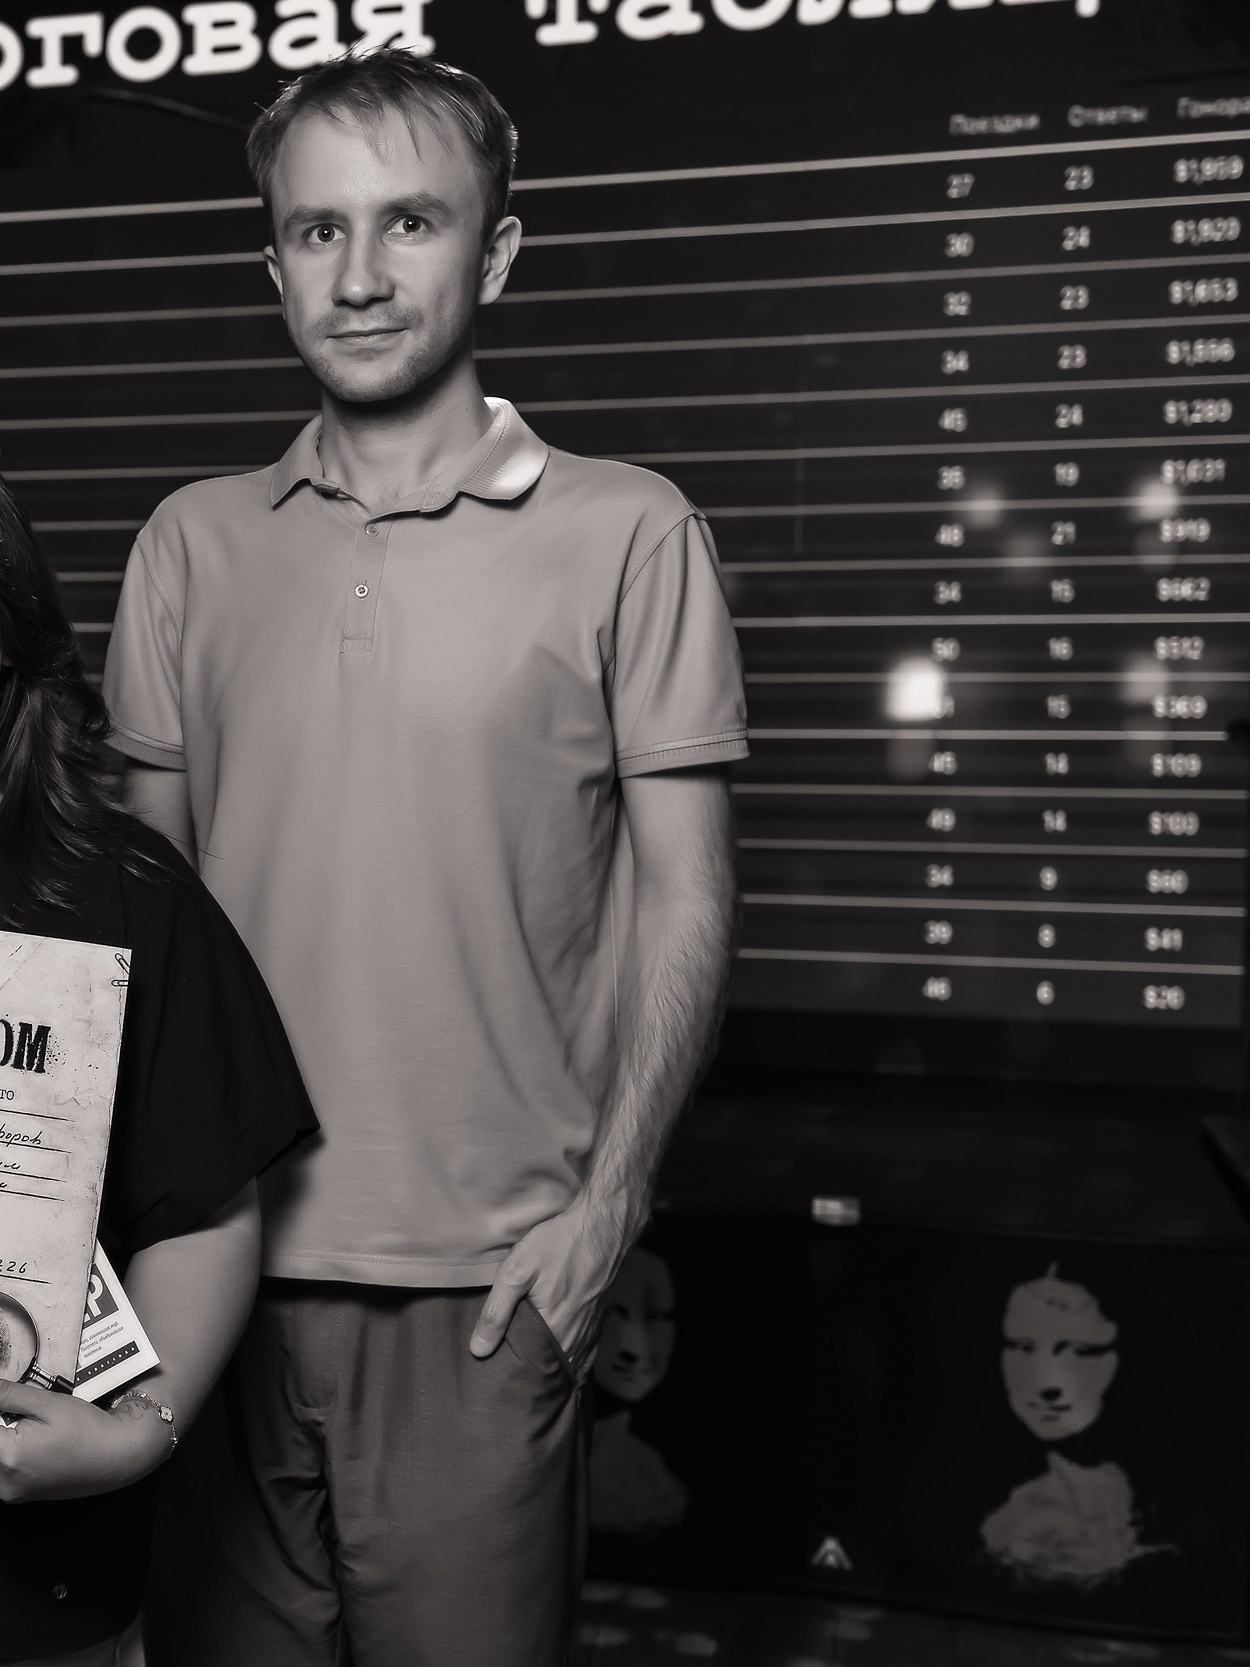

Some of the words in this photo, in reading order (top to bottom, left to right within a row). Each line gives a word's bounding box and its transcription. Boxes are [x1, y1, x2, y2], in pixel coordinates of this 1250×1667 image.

[1065, 166, 1093, 190] 23
[1063, 227, 1090, 250] 24
[1060, 286, 1089, 310] 23
[1058, 345, 1086, 369] 23
[1056, 404, 1083, 428] 24
[1055, 462, 1079, 485] 19
[1052, 521, 1076, 545] 21
[1051, 579, 1074, 602] 15
[1049, 637, 1072, 660] 16
[1048, 695, 1070, 718] 15
[1046, 752, 1068, 774] 14
[1044, 811, 1066, 831] 14
[1040, 867, 1057, 890] 9
[1038, 925, 1055, 947] 8
[1037, 981, 1054, 1004] 6
